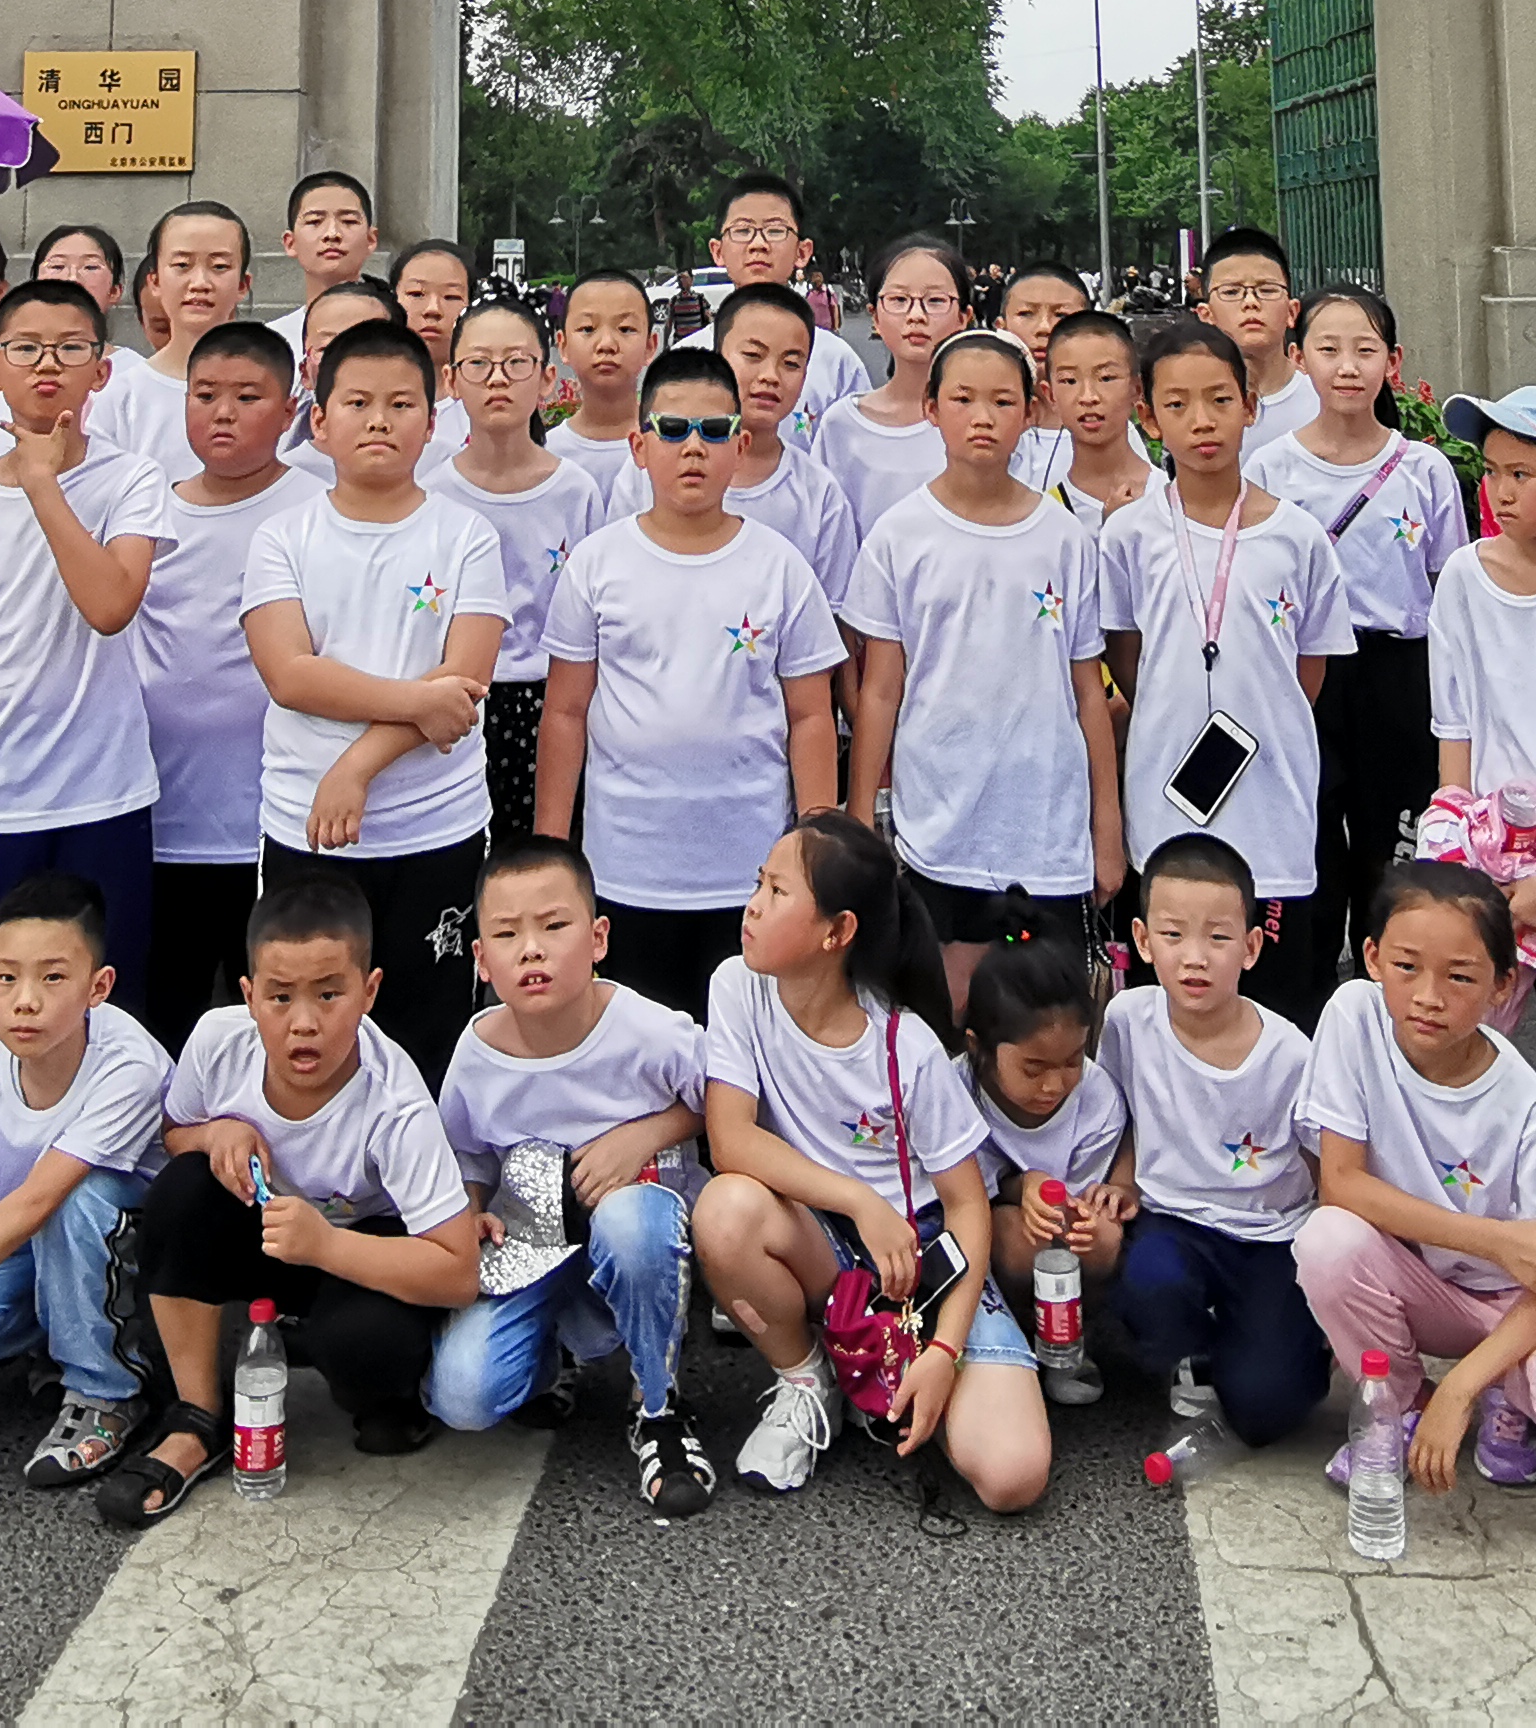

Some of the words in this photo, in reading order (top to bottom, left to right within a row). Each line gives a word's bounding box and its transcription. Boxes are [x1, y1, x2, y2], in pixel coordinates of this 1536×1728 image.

[37, 68, 181, 93] 清华园
[57, 98, 160, 110] QINGHUAYUAN
[83, 121, 133, 145] 西门
